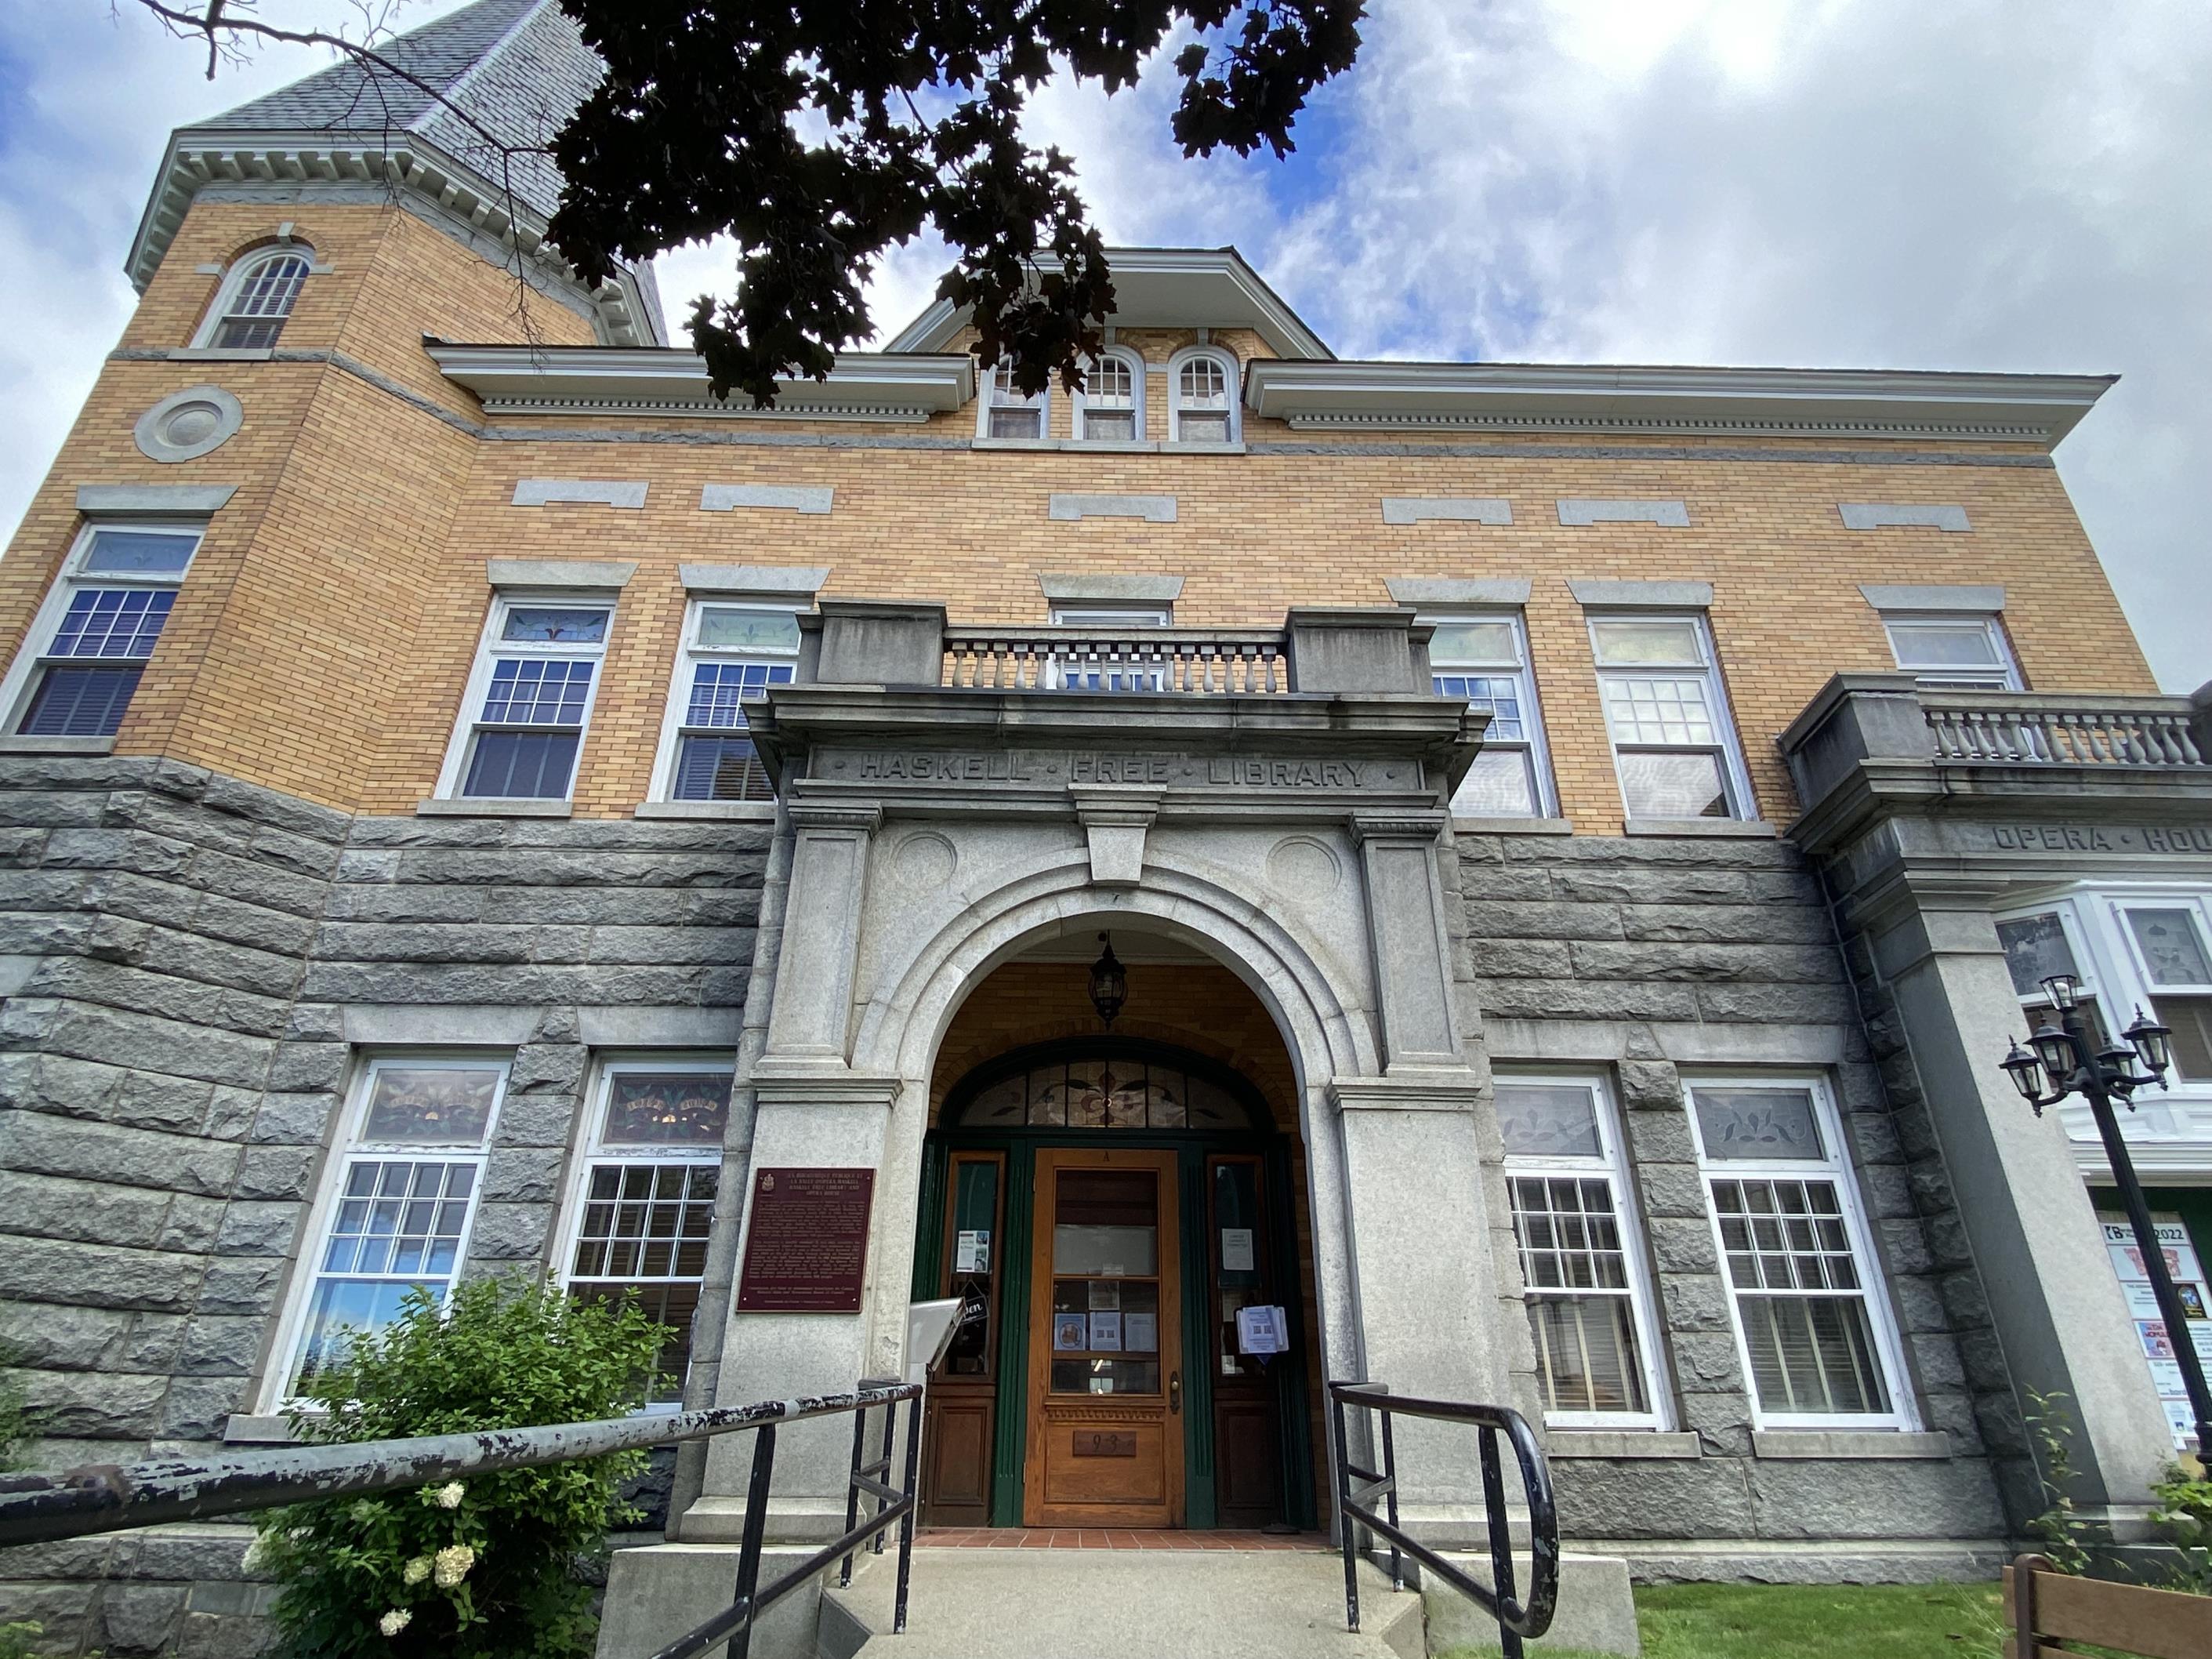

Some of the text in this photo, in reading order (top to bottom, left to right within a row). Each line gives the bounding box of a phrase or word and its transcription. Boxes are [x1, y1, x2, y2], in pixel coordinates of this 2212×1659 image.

[860, 753, 1366, 787] HASKELL FREE LIBRARY
[1992, 826, 2114, 851] OPERA
[2153, 1229, 2185, 1240] 2022
